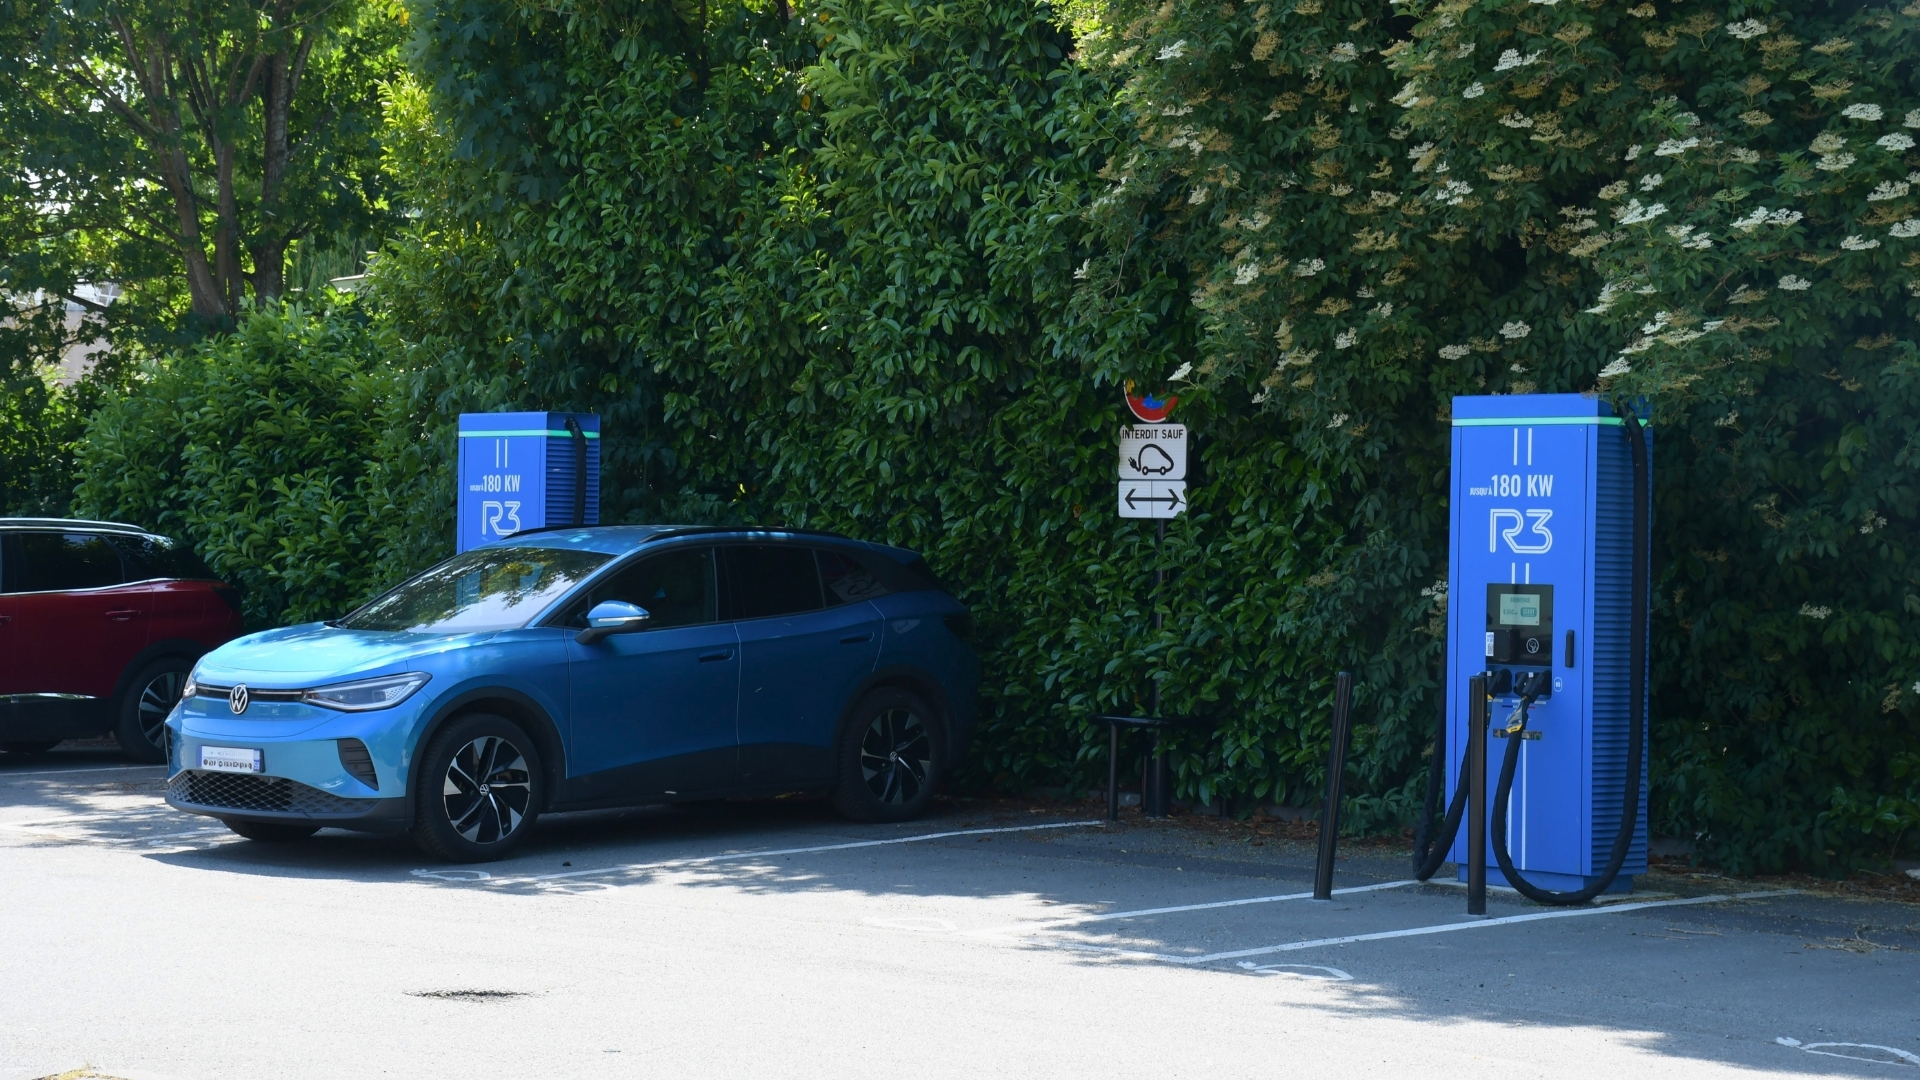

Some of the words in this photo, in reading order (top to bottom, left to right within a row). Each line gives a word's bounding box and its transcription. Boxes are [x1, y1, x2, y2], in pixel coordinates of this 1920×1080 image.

[1122, 429, 1158, 440] INTERDIT
[1161, 429, 1184, 439] SAUF
[482, 475, 501, 492] 180
[504, 475, 521, 492] KW
[1469, 486, 1492, 496] JUSQU'À
[1491, 474, 1521, 497] 180
[1527, 474, 1554, 497] KW
[482, 501, 521, 536] R3
[1489, 508, 1554, 554] R3
